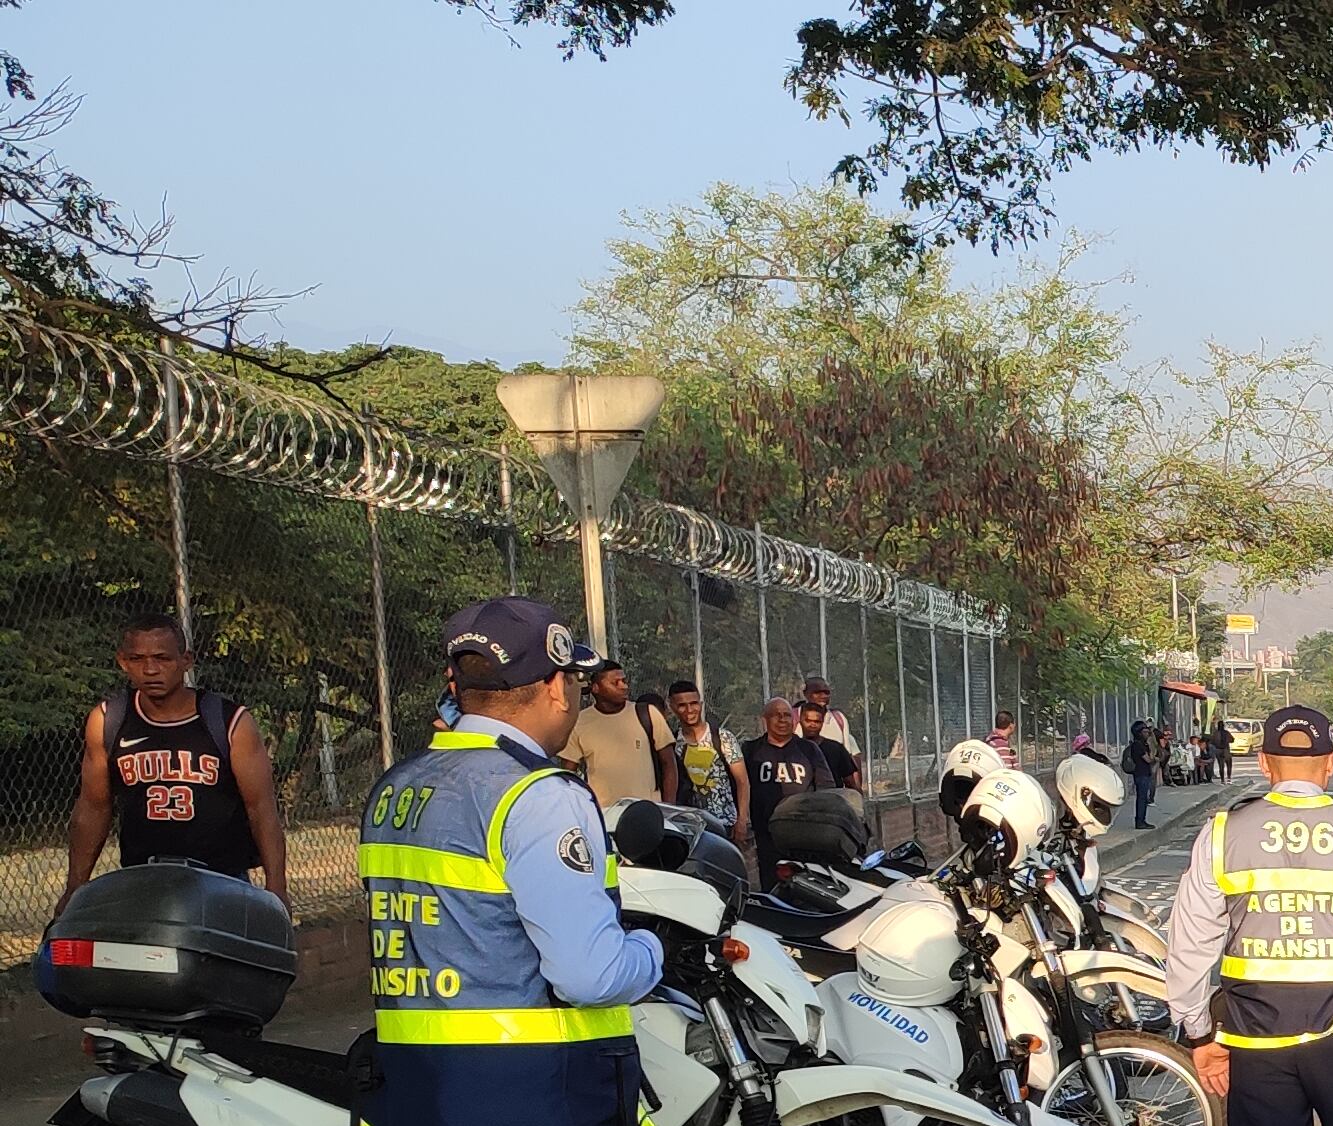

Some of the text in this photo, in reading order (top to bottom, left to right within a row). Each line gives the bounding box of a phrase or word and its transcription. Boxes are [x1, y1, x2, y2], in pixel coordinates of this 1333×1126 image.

[117, 749, 220, 786] BULLS
[760, 761, 806, 785] GAP
[146, 785, 195, 821] 23
[372, 784, 436, 832] 697
[371, 891, 441, 925] ENTE
[1280, 916, 1314, 936] DE
[373, 929, 406, 959] DE
[370, 967, 461, 998] ANSITO
[848, 992, 929, 1044] MOVILIDAD
